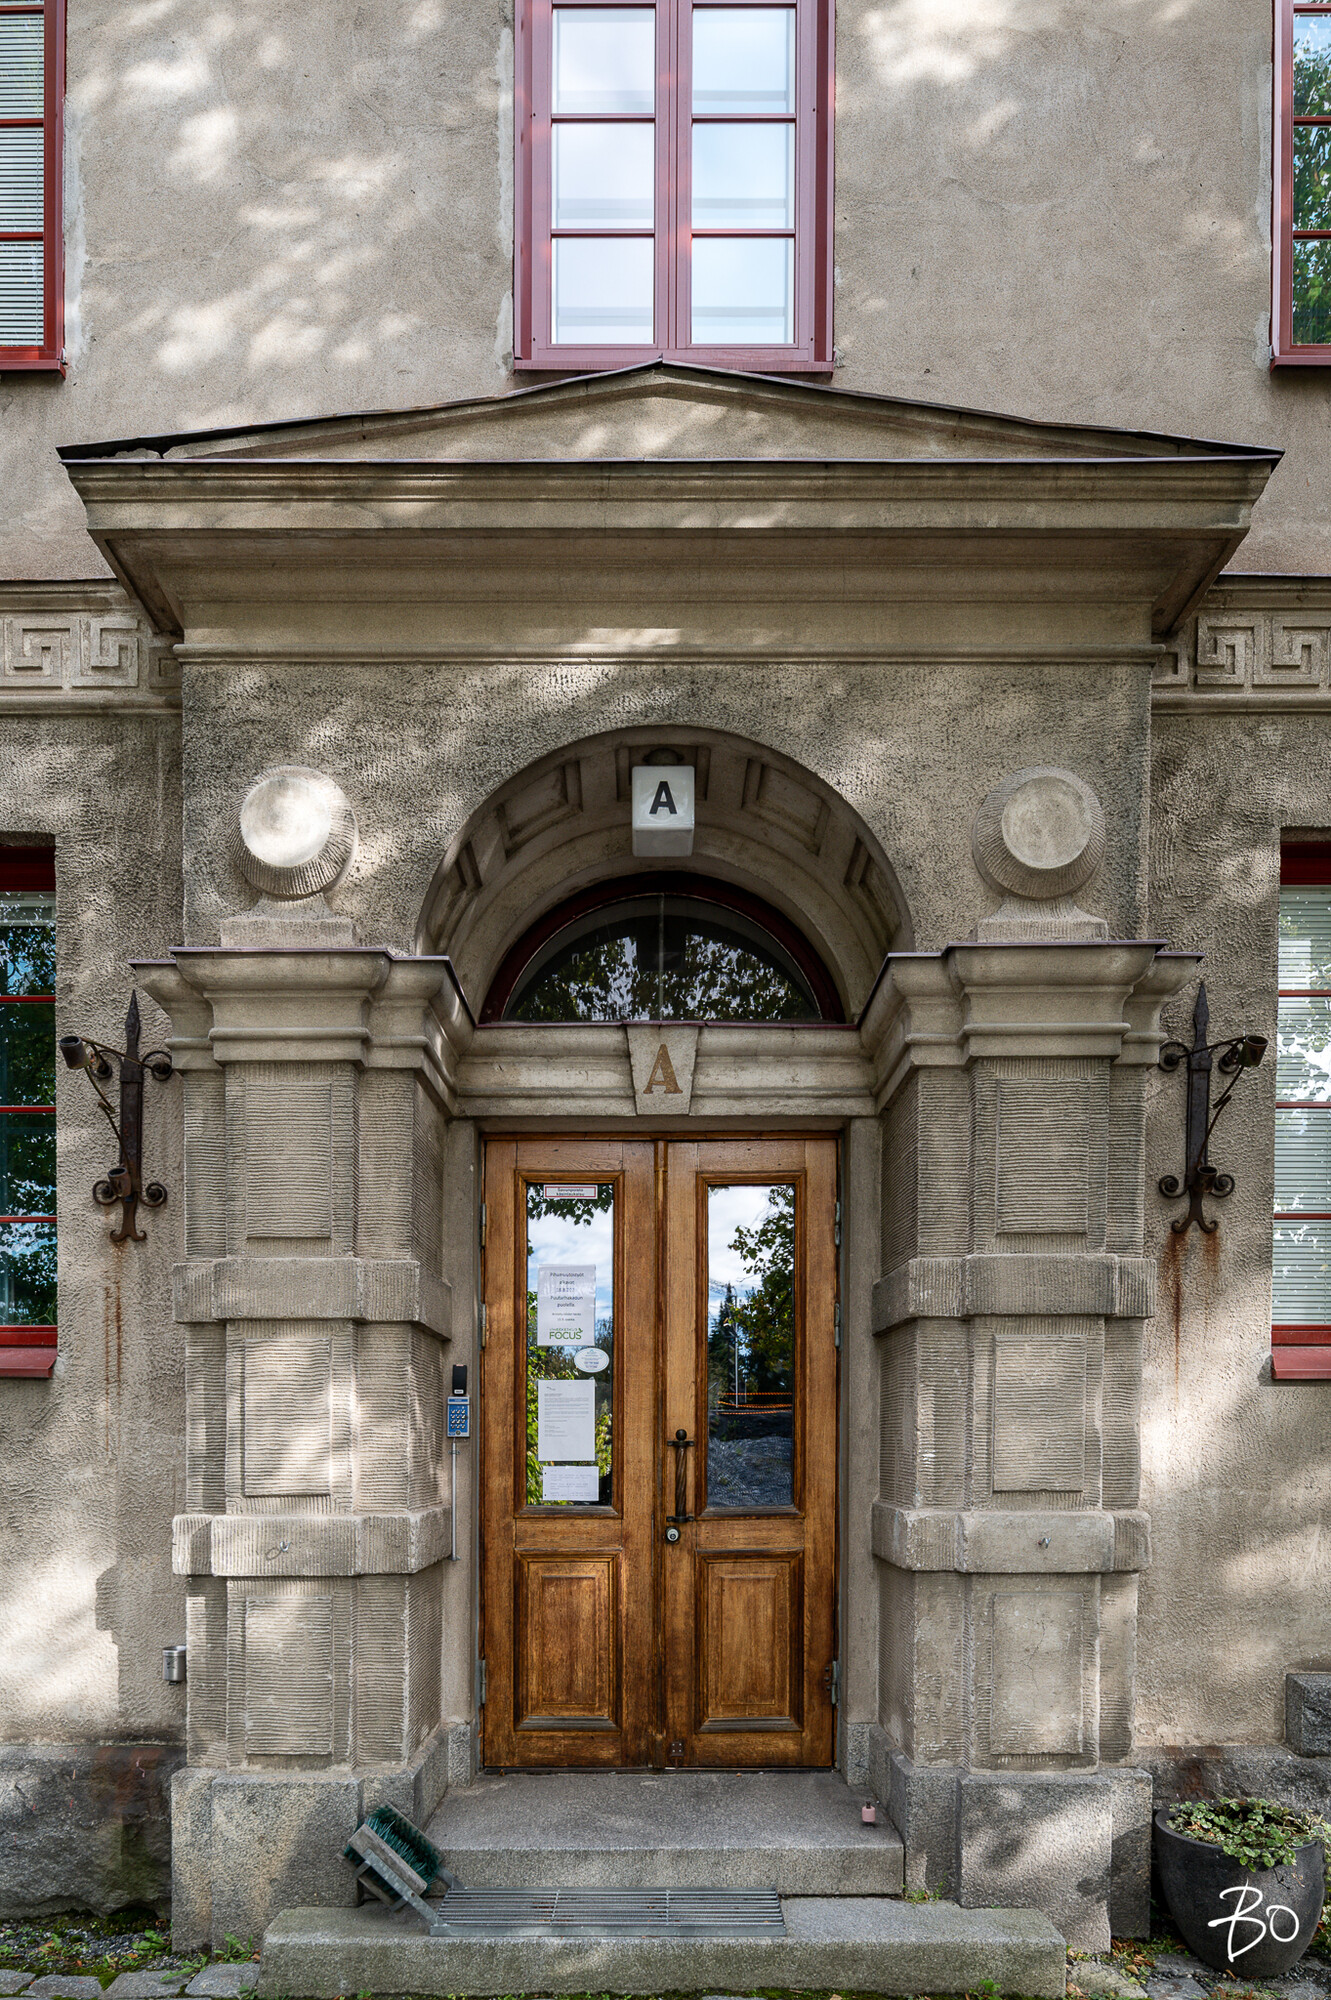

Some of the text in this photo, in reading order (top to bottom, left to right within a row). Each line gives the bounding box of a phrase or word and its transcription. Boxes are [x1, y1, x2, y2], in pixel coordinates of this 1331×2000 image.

[649, 780, 678, 815] A
[642, 1043, 684, 1095] A
[549, 1331, 582, 1339] FOCUS
